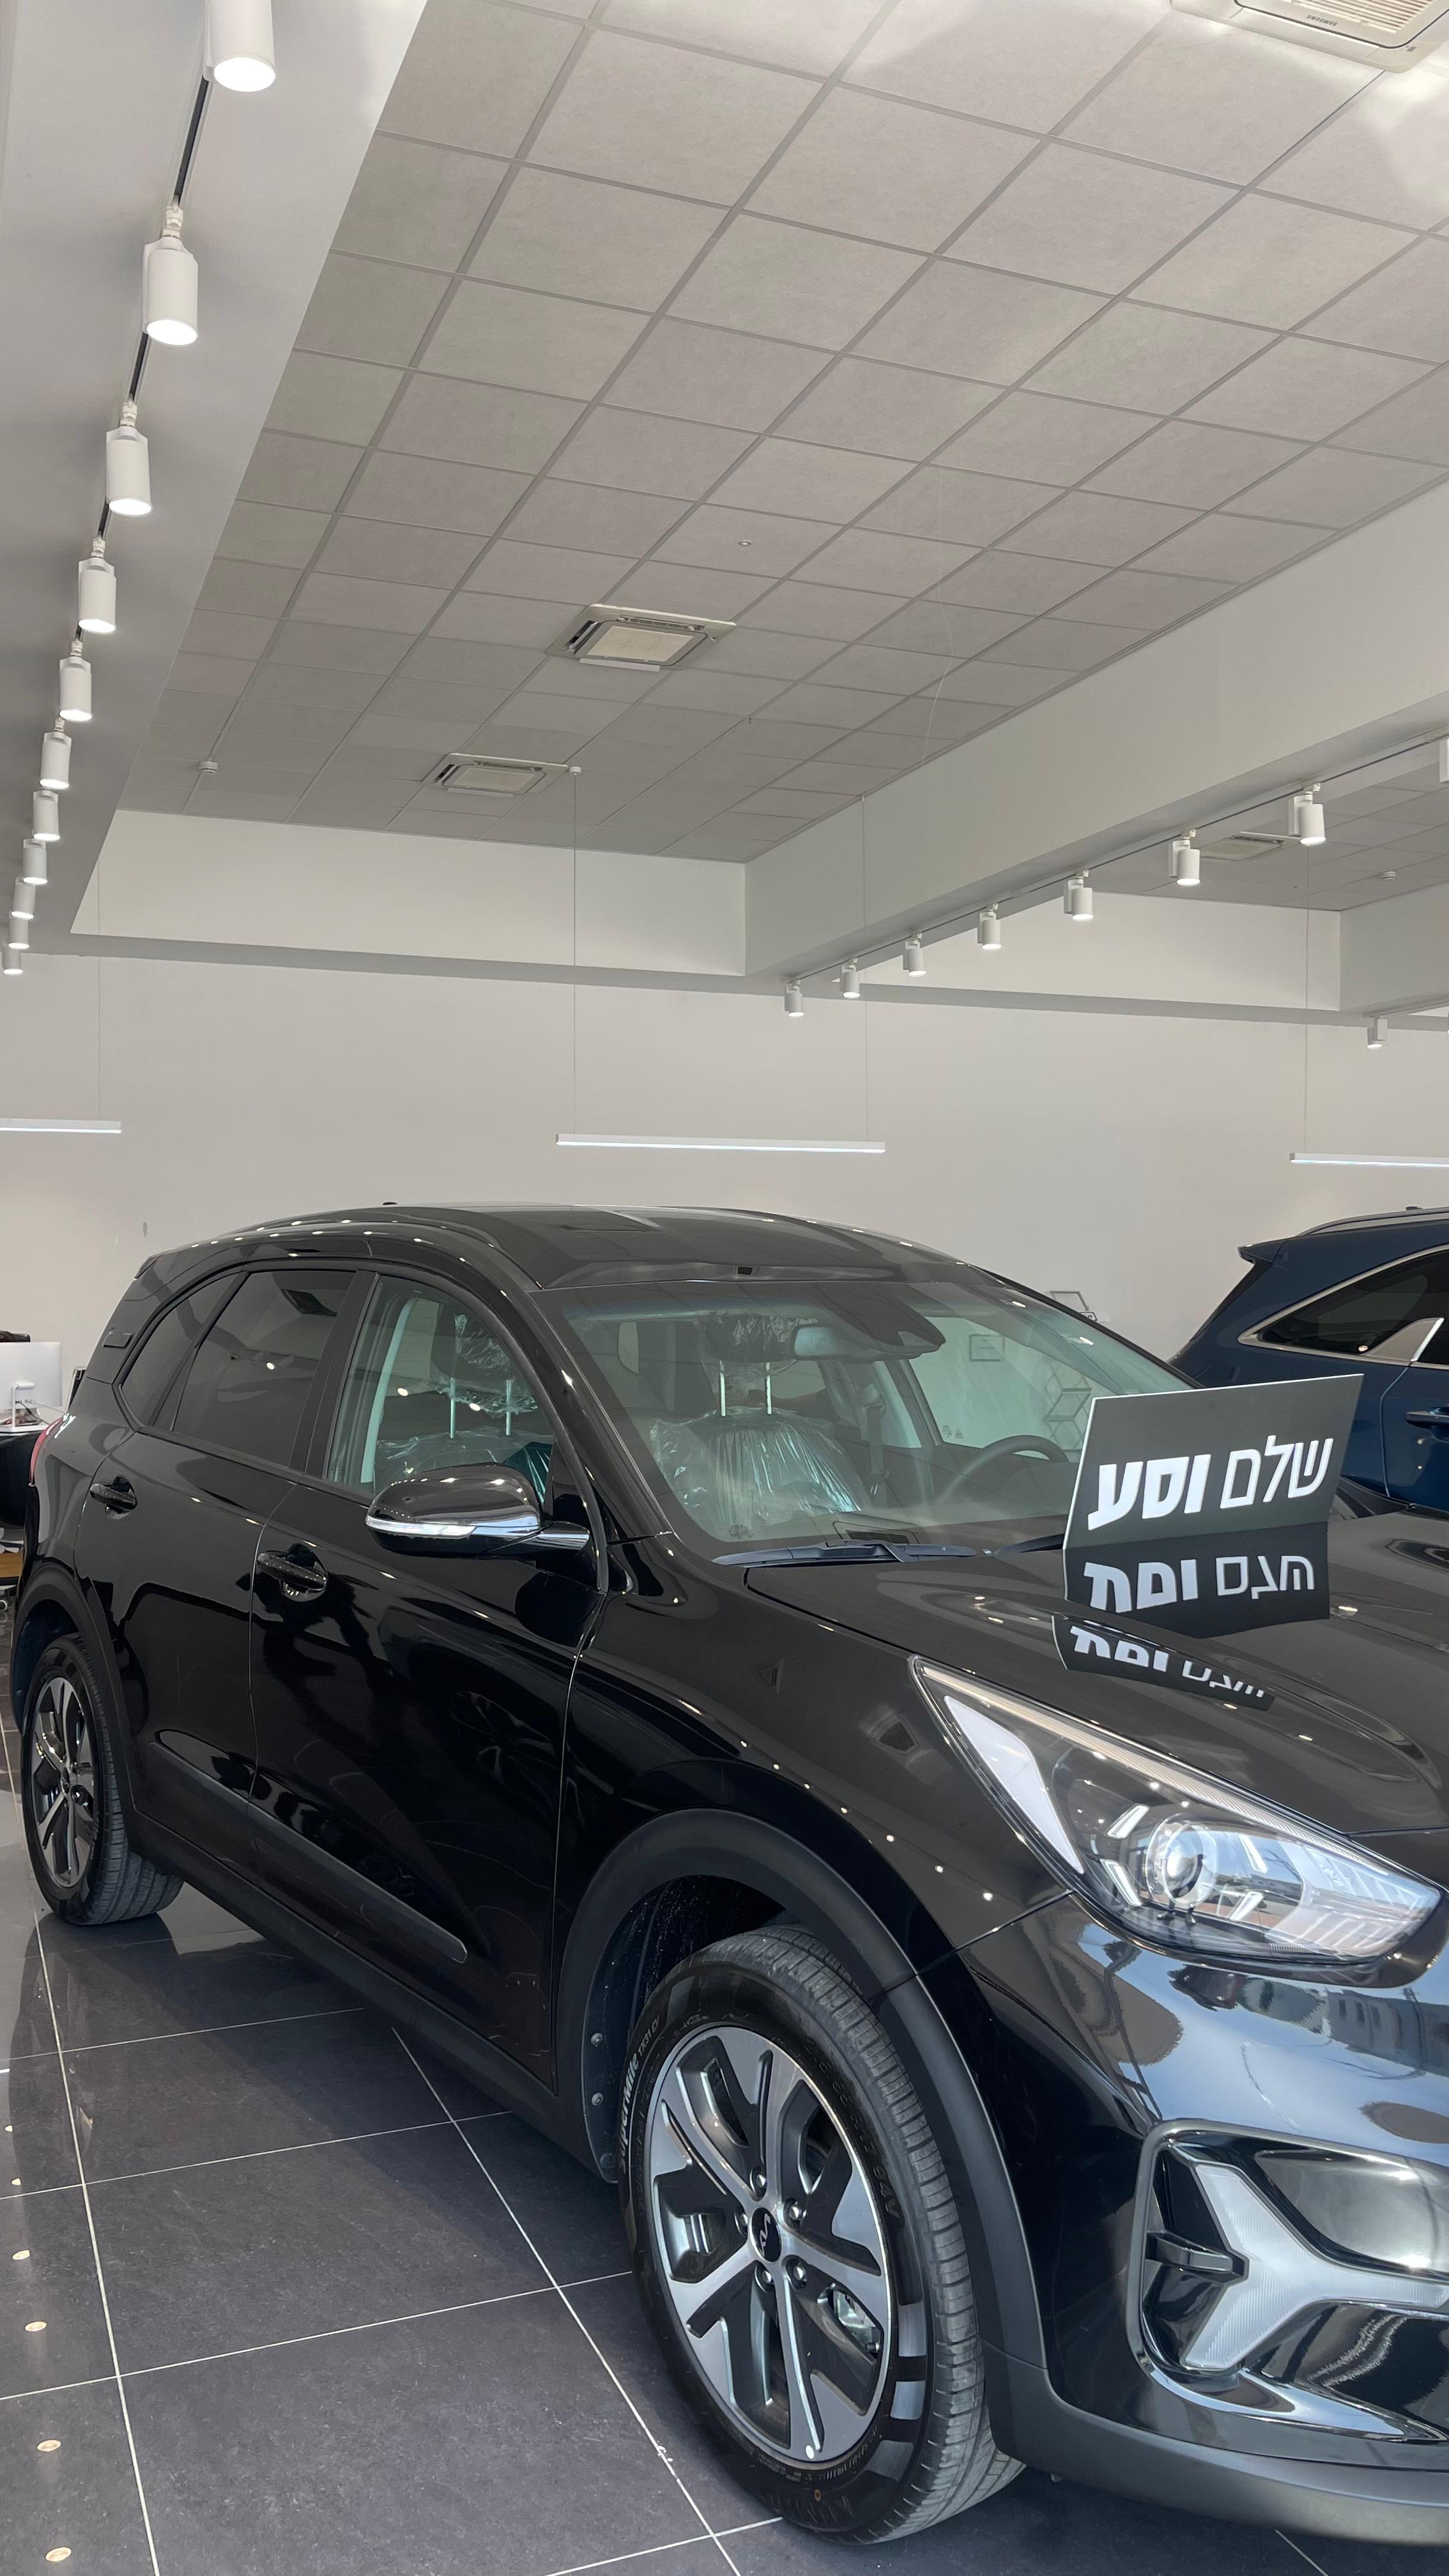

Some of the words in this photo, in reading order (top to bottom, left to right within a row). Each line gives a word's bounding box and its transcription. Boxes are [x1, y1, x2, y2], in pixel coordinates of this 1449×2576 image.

[1307, 15, 1338, 26] SAMSUNG
[1087, 1454, 1211, 1531] וסע
[1220, 1435, 1334, 1510] שלם
[638, 2028, 652, 2057] TX31
[651, 2014, 660, 2031] EV
[873, 2164, 900, 2220] 94V
